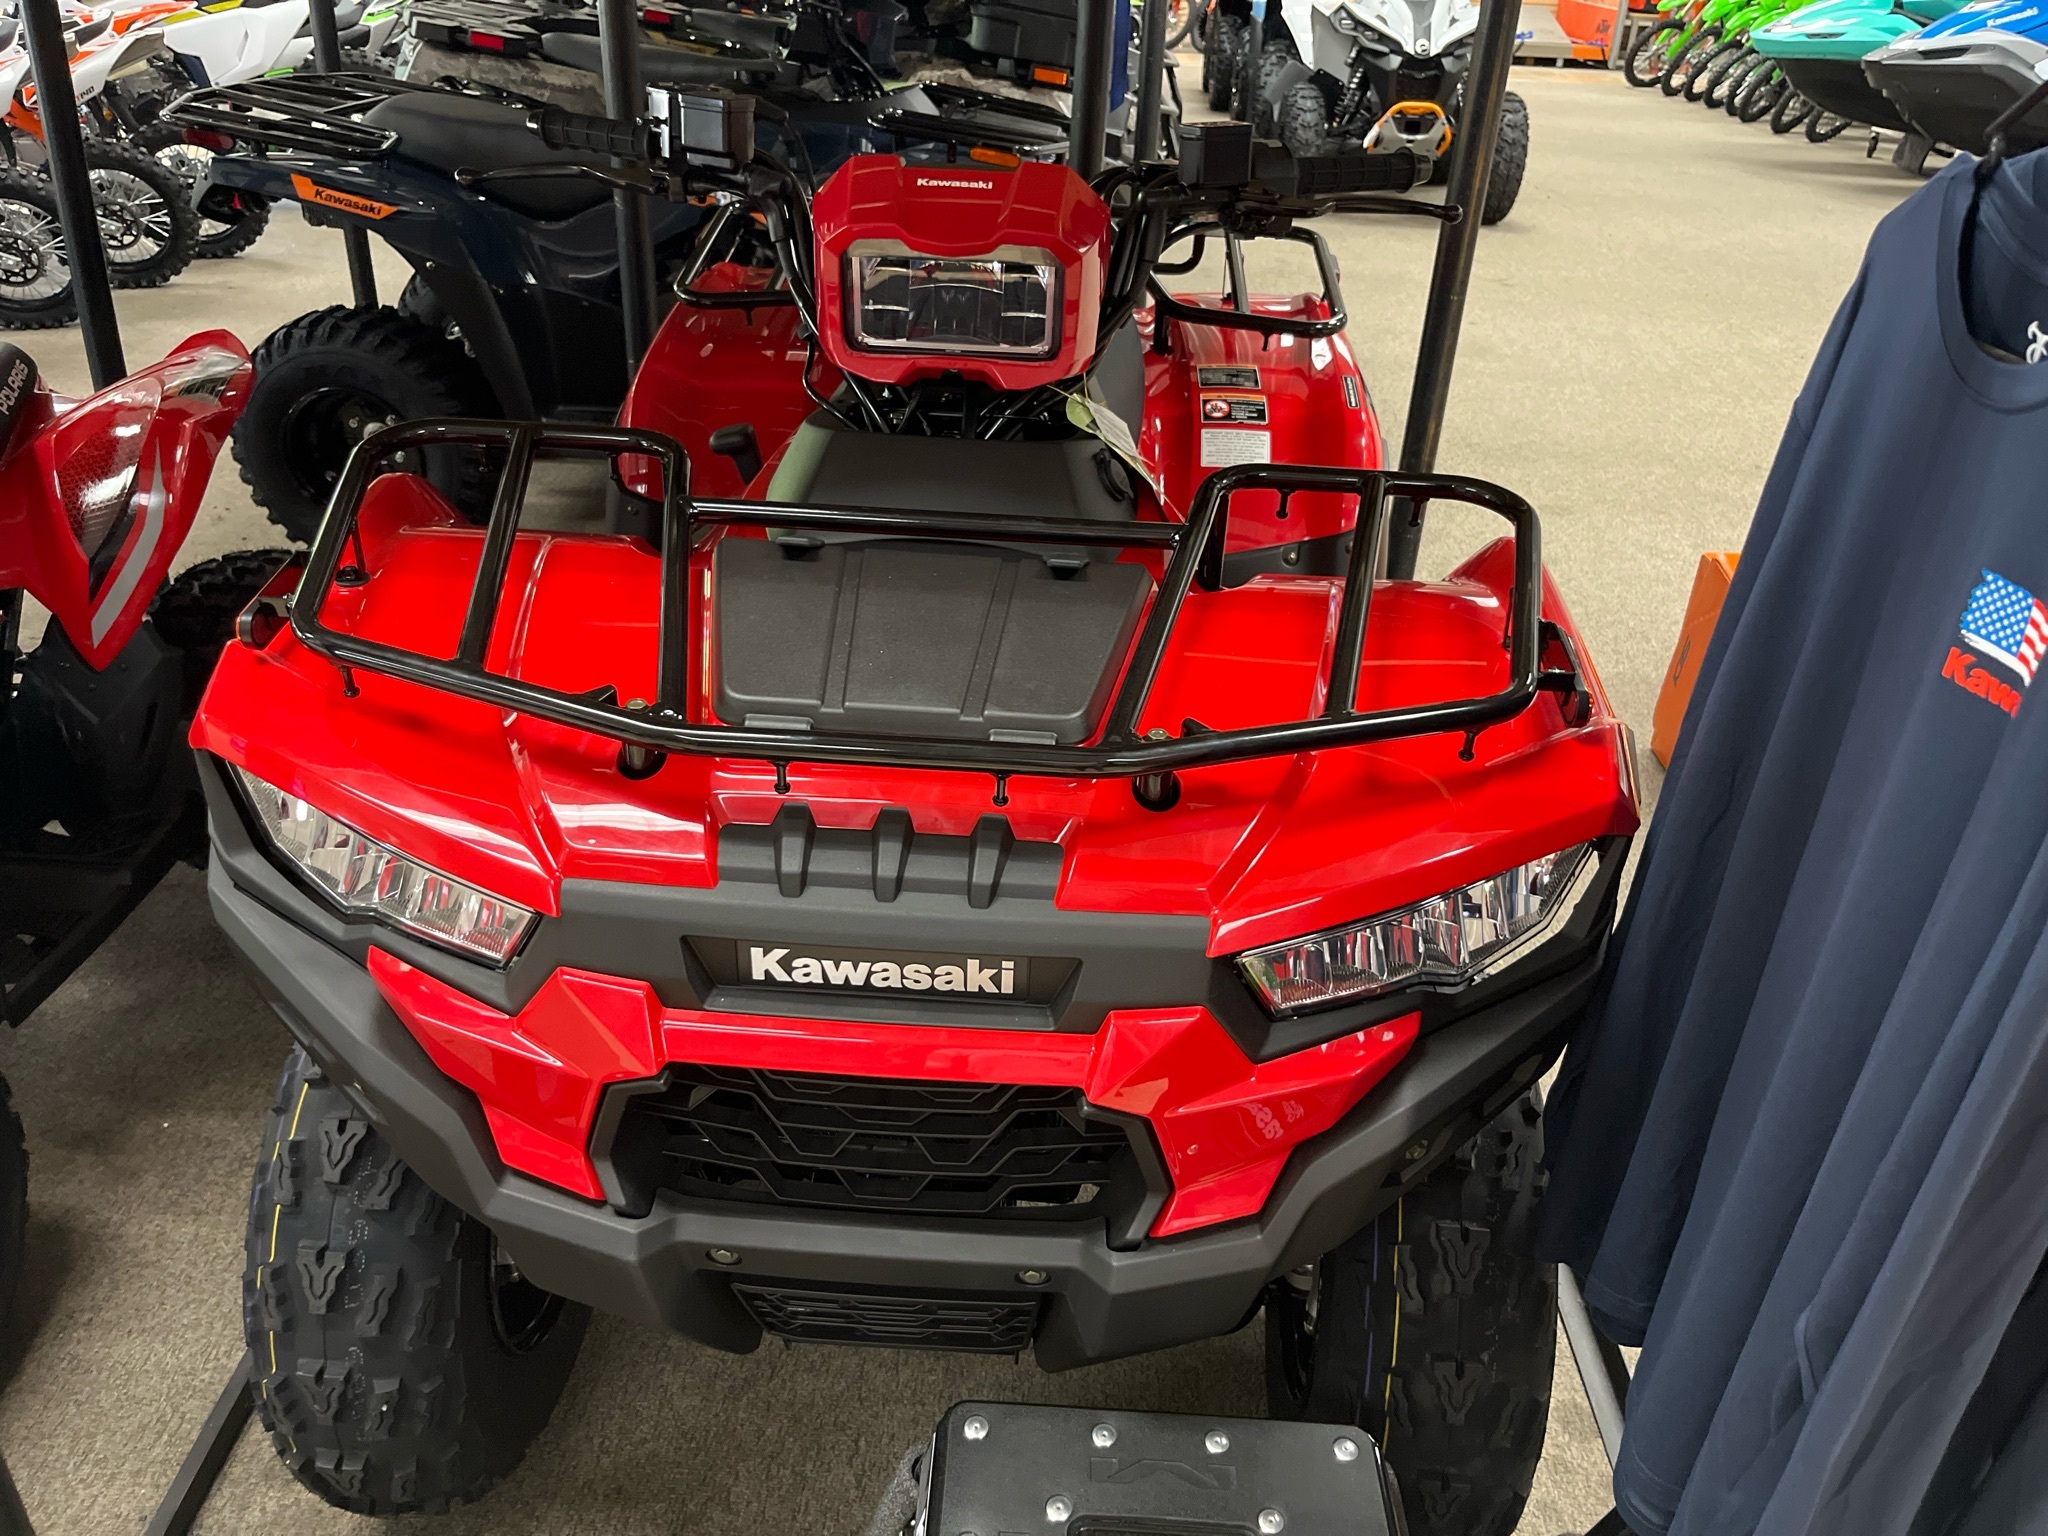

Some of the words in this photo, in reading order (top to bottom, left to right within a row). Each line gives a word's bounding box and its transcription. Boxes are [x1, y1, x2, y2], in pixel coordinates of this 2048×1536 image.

[314, 188, 382, 216] Kawasaki
[916, 178, 993, 190] Kawasaki
[0, 359, 29, 415] POLARIS
[750, 946, 1015, 994] Kawasaki
